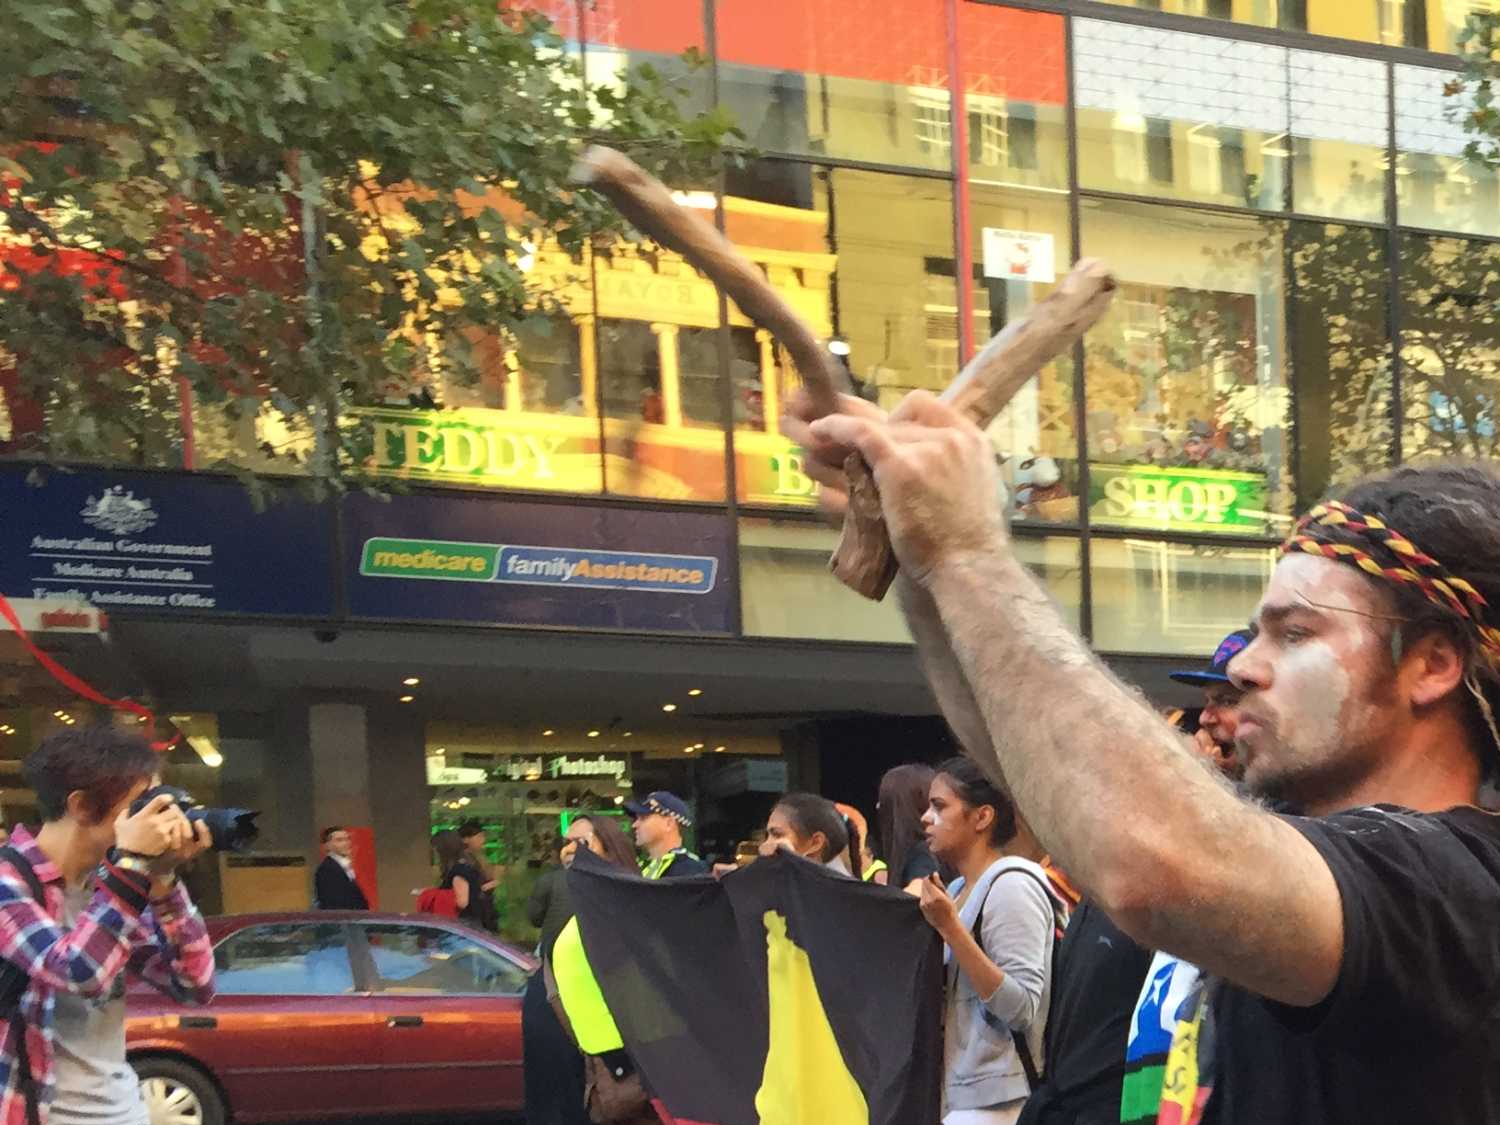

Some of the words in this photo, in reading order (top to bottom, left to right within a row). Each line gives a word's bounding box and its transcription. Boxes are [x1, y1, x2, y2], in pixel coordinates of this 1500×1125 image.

[372, 422, 566, 478] TEDDY
[1104, 476, 1237, 523] SHOP
[371, 549, 488, 573] medicare
[505, 554, 705, 584] familyAssistance
